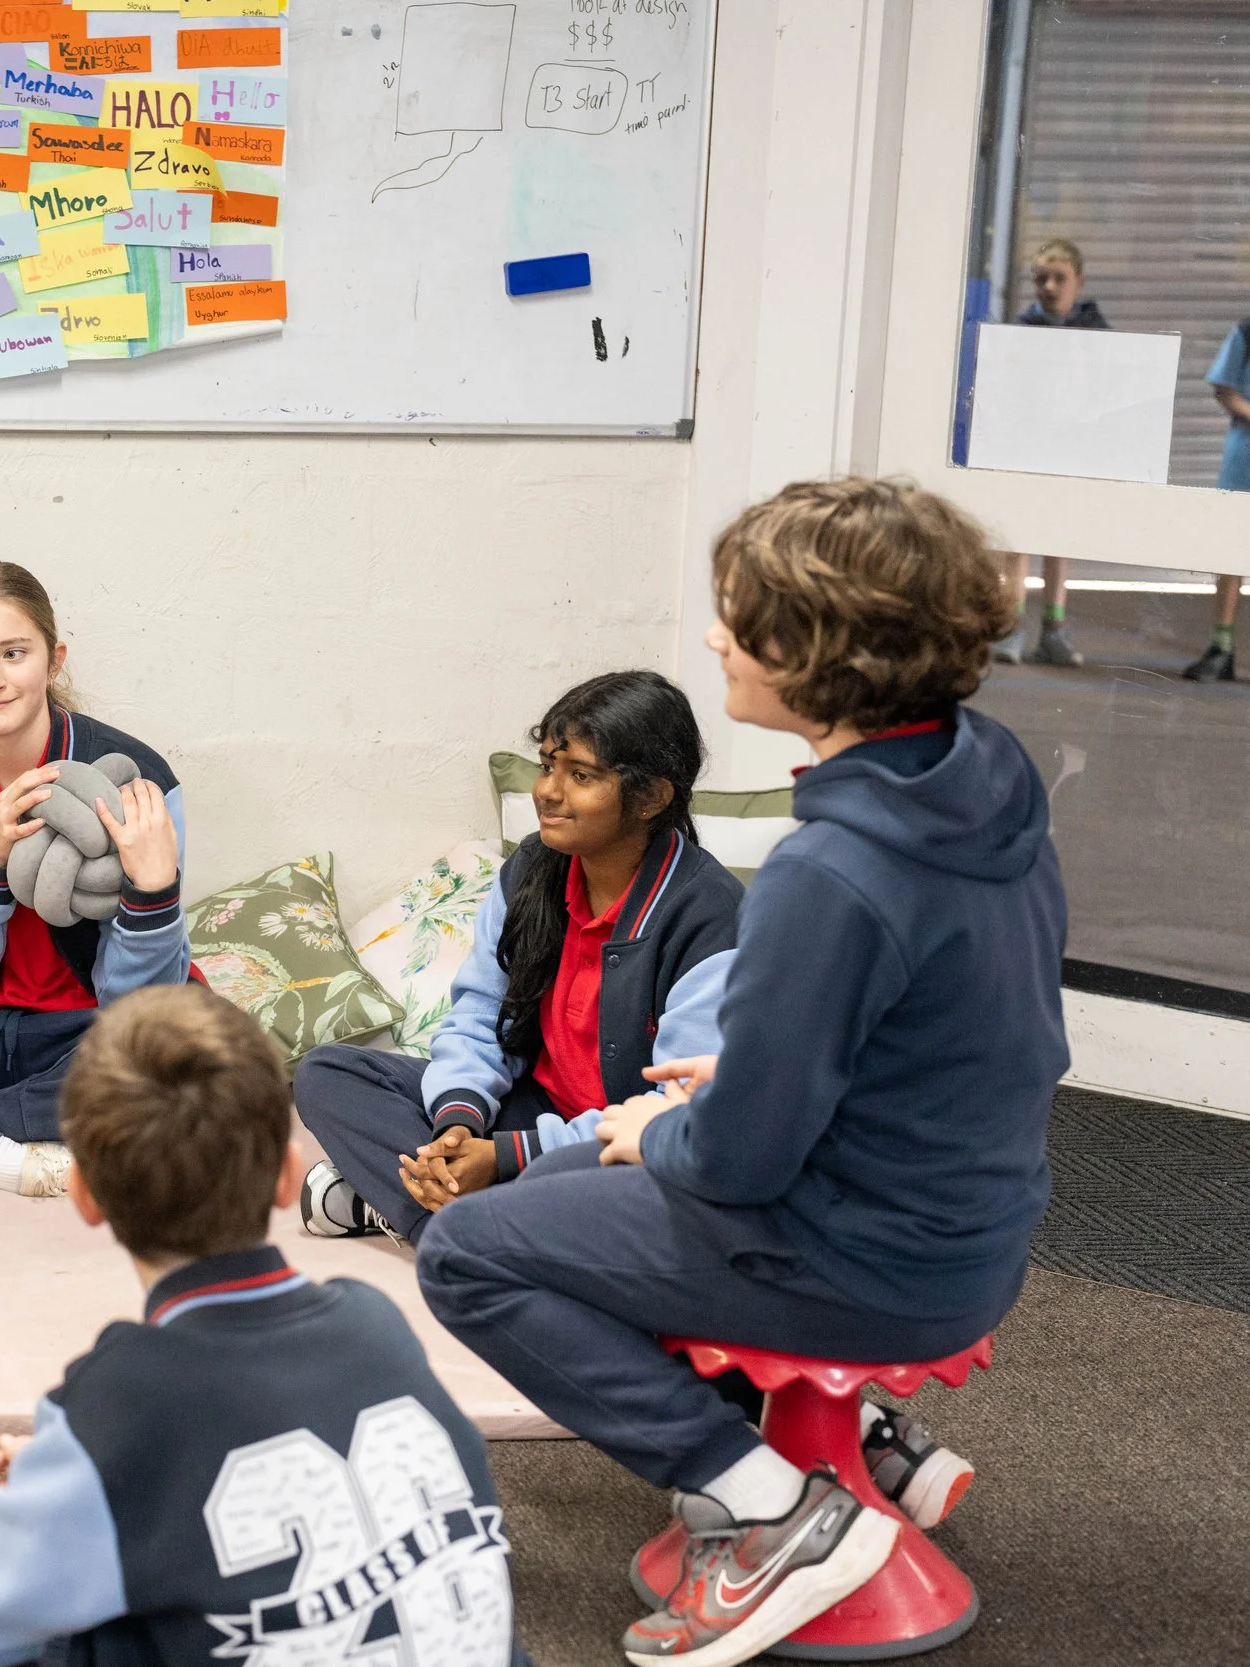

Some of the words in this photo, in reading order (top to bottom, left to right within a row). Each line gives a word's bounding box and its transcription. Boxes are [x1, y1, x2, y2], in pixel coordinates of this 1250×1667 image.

[4, 69, 94, 100] Merhaba
[211, 80, 281, 110] Hello
[573, 81, 613, 110] Start
[14, 92, 51, 107] Turkish
[111, 90, 191, 129] HALO
[51, 151, 77, 163] Thai
[134, 147, 211, 176] Zdravo
[30, 187, 108, 226] Mhoro
[179, 252, 221, 273] Hola
[40, 306, 101, 332] drvo
[296, 1541, 416, 1628] CLASS
[413, 1514, 452, 1558] OF
